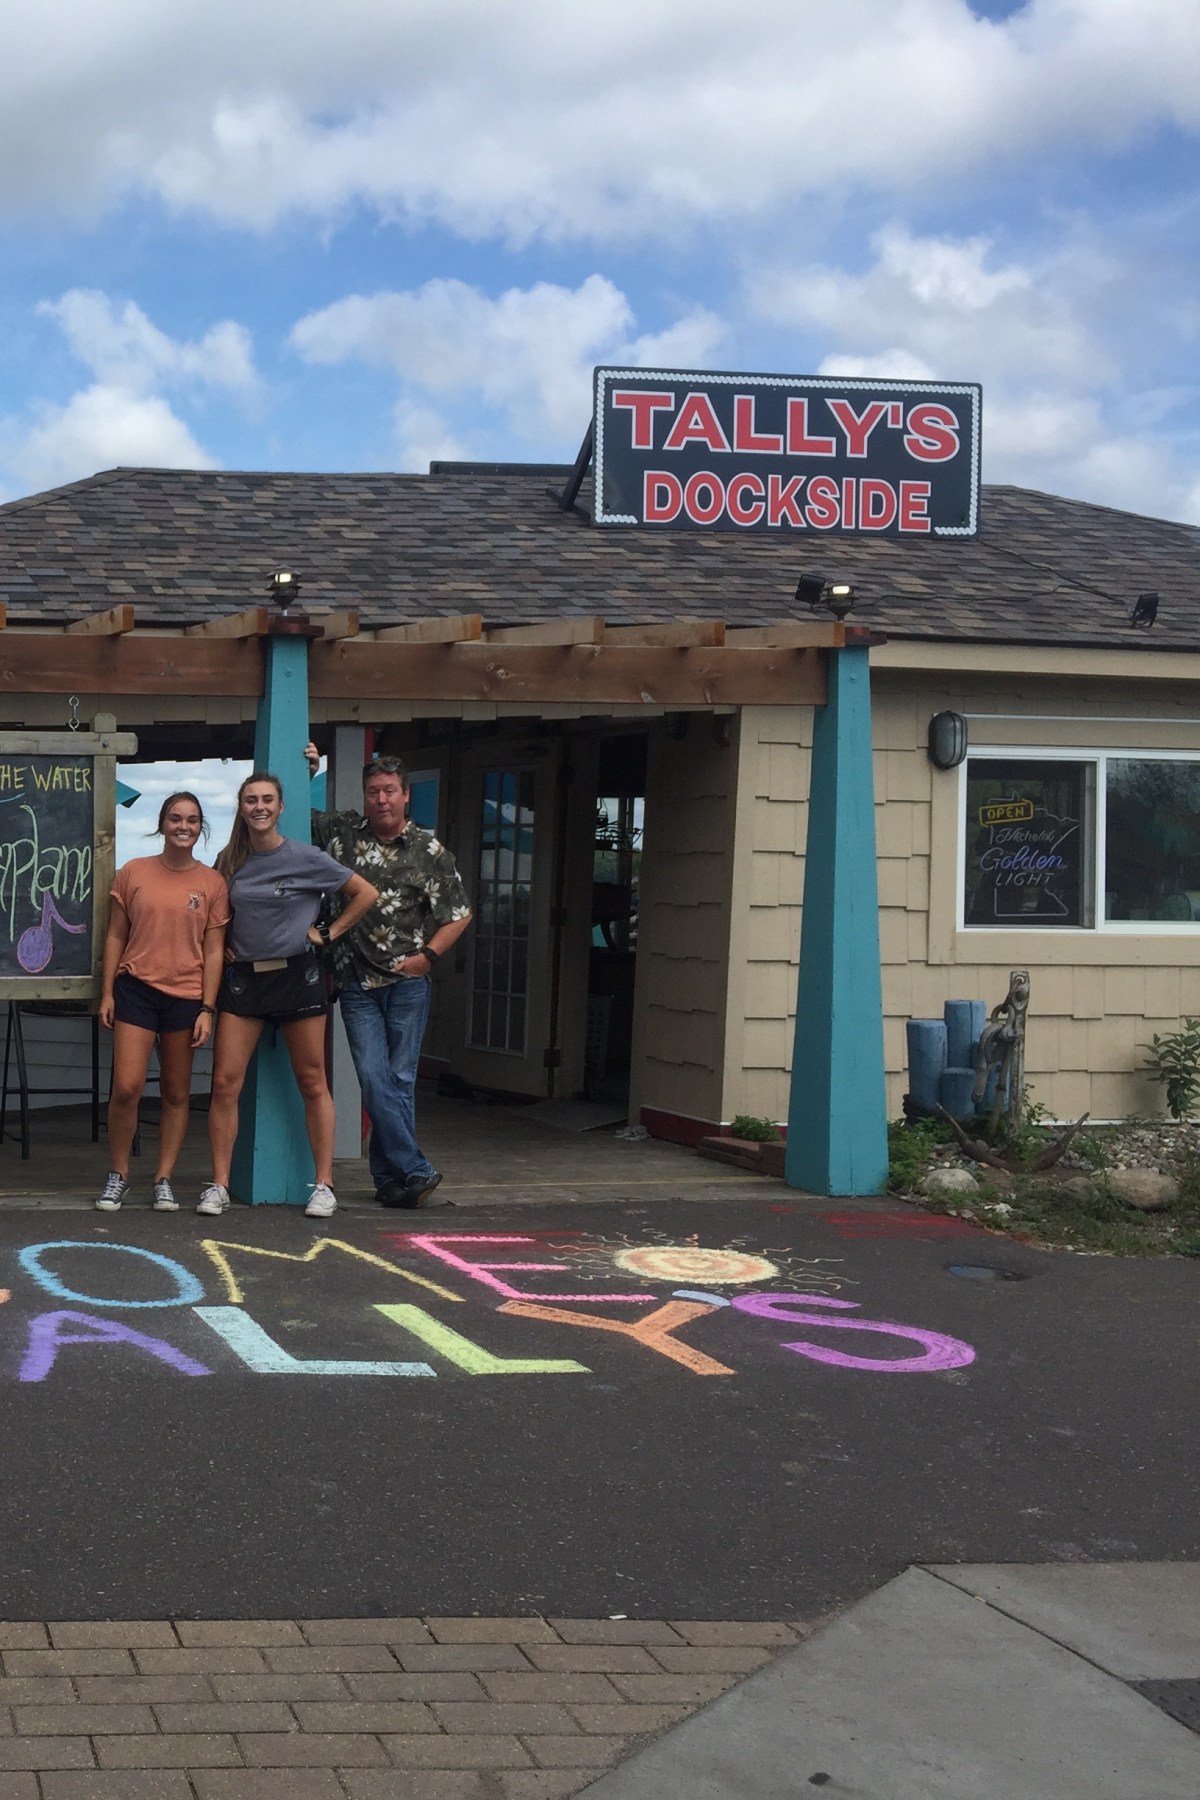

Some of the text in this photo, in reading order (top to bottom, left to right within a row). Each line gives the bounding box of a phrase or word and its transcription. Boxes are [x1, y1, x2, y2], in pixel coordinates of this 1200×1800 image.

[612, 390, 960, 463] TALLY'S
[643, 470, 931, 533] DOCKSIDE
[31, 765, 92, 792] WATER
[987, 806, 1024, 820] OPEN
[980, 845, 1067, 871] Golden
[995, 872, 1054, 886] LIGHT
